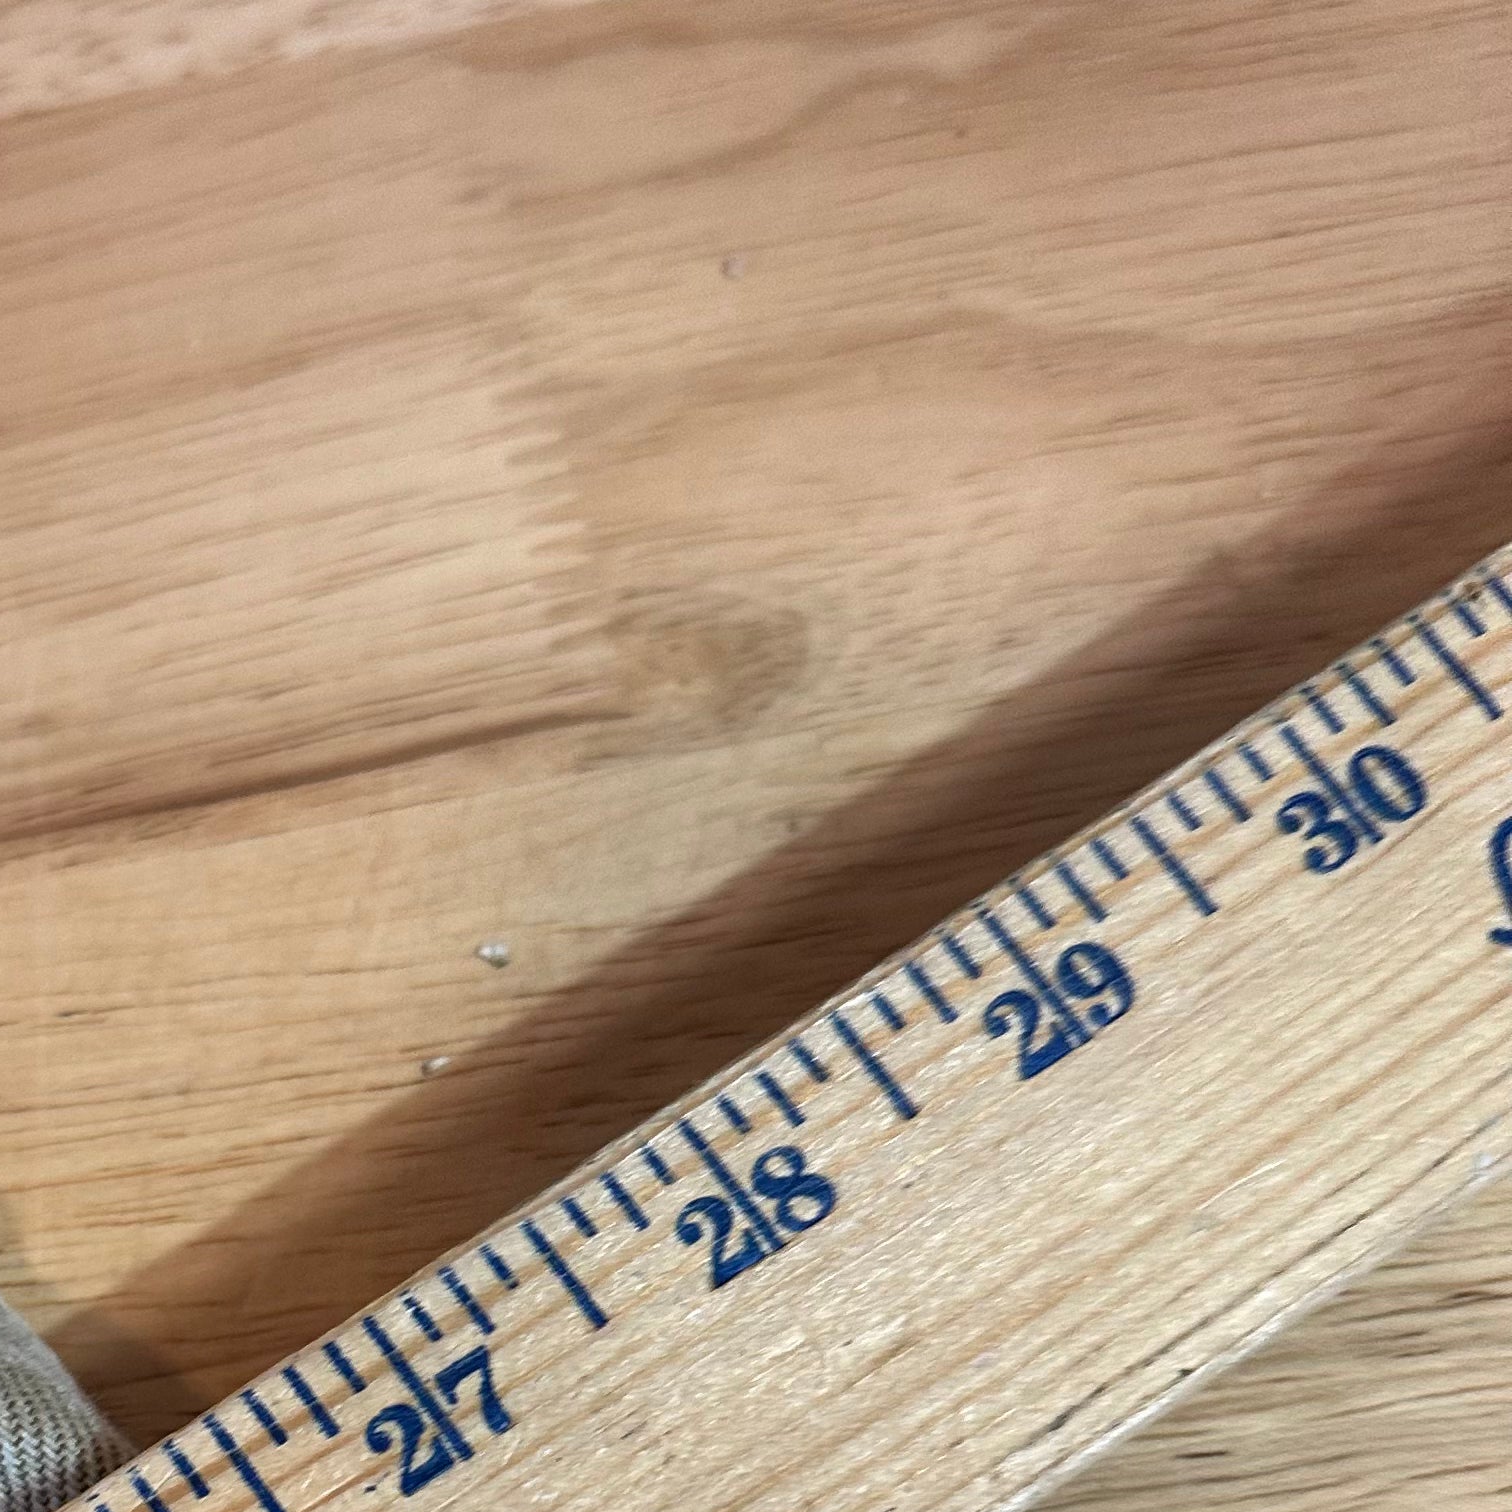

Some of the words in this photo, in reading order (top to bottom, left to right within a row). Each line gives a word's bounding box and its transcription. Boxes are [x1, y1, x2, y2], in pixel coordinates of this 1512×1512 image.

[1276, 744, 1427, 875] 30
[984, 941, 1137, 1080] 29
[675, 1146, 838, 1289] 28
[365, 1345, 511, 1496] 27
